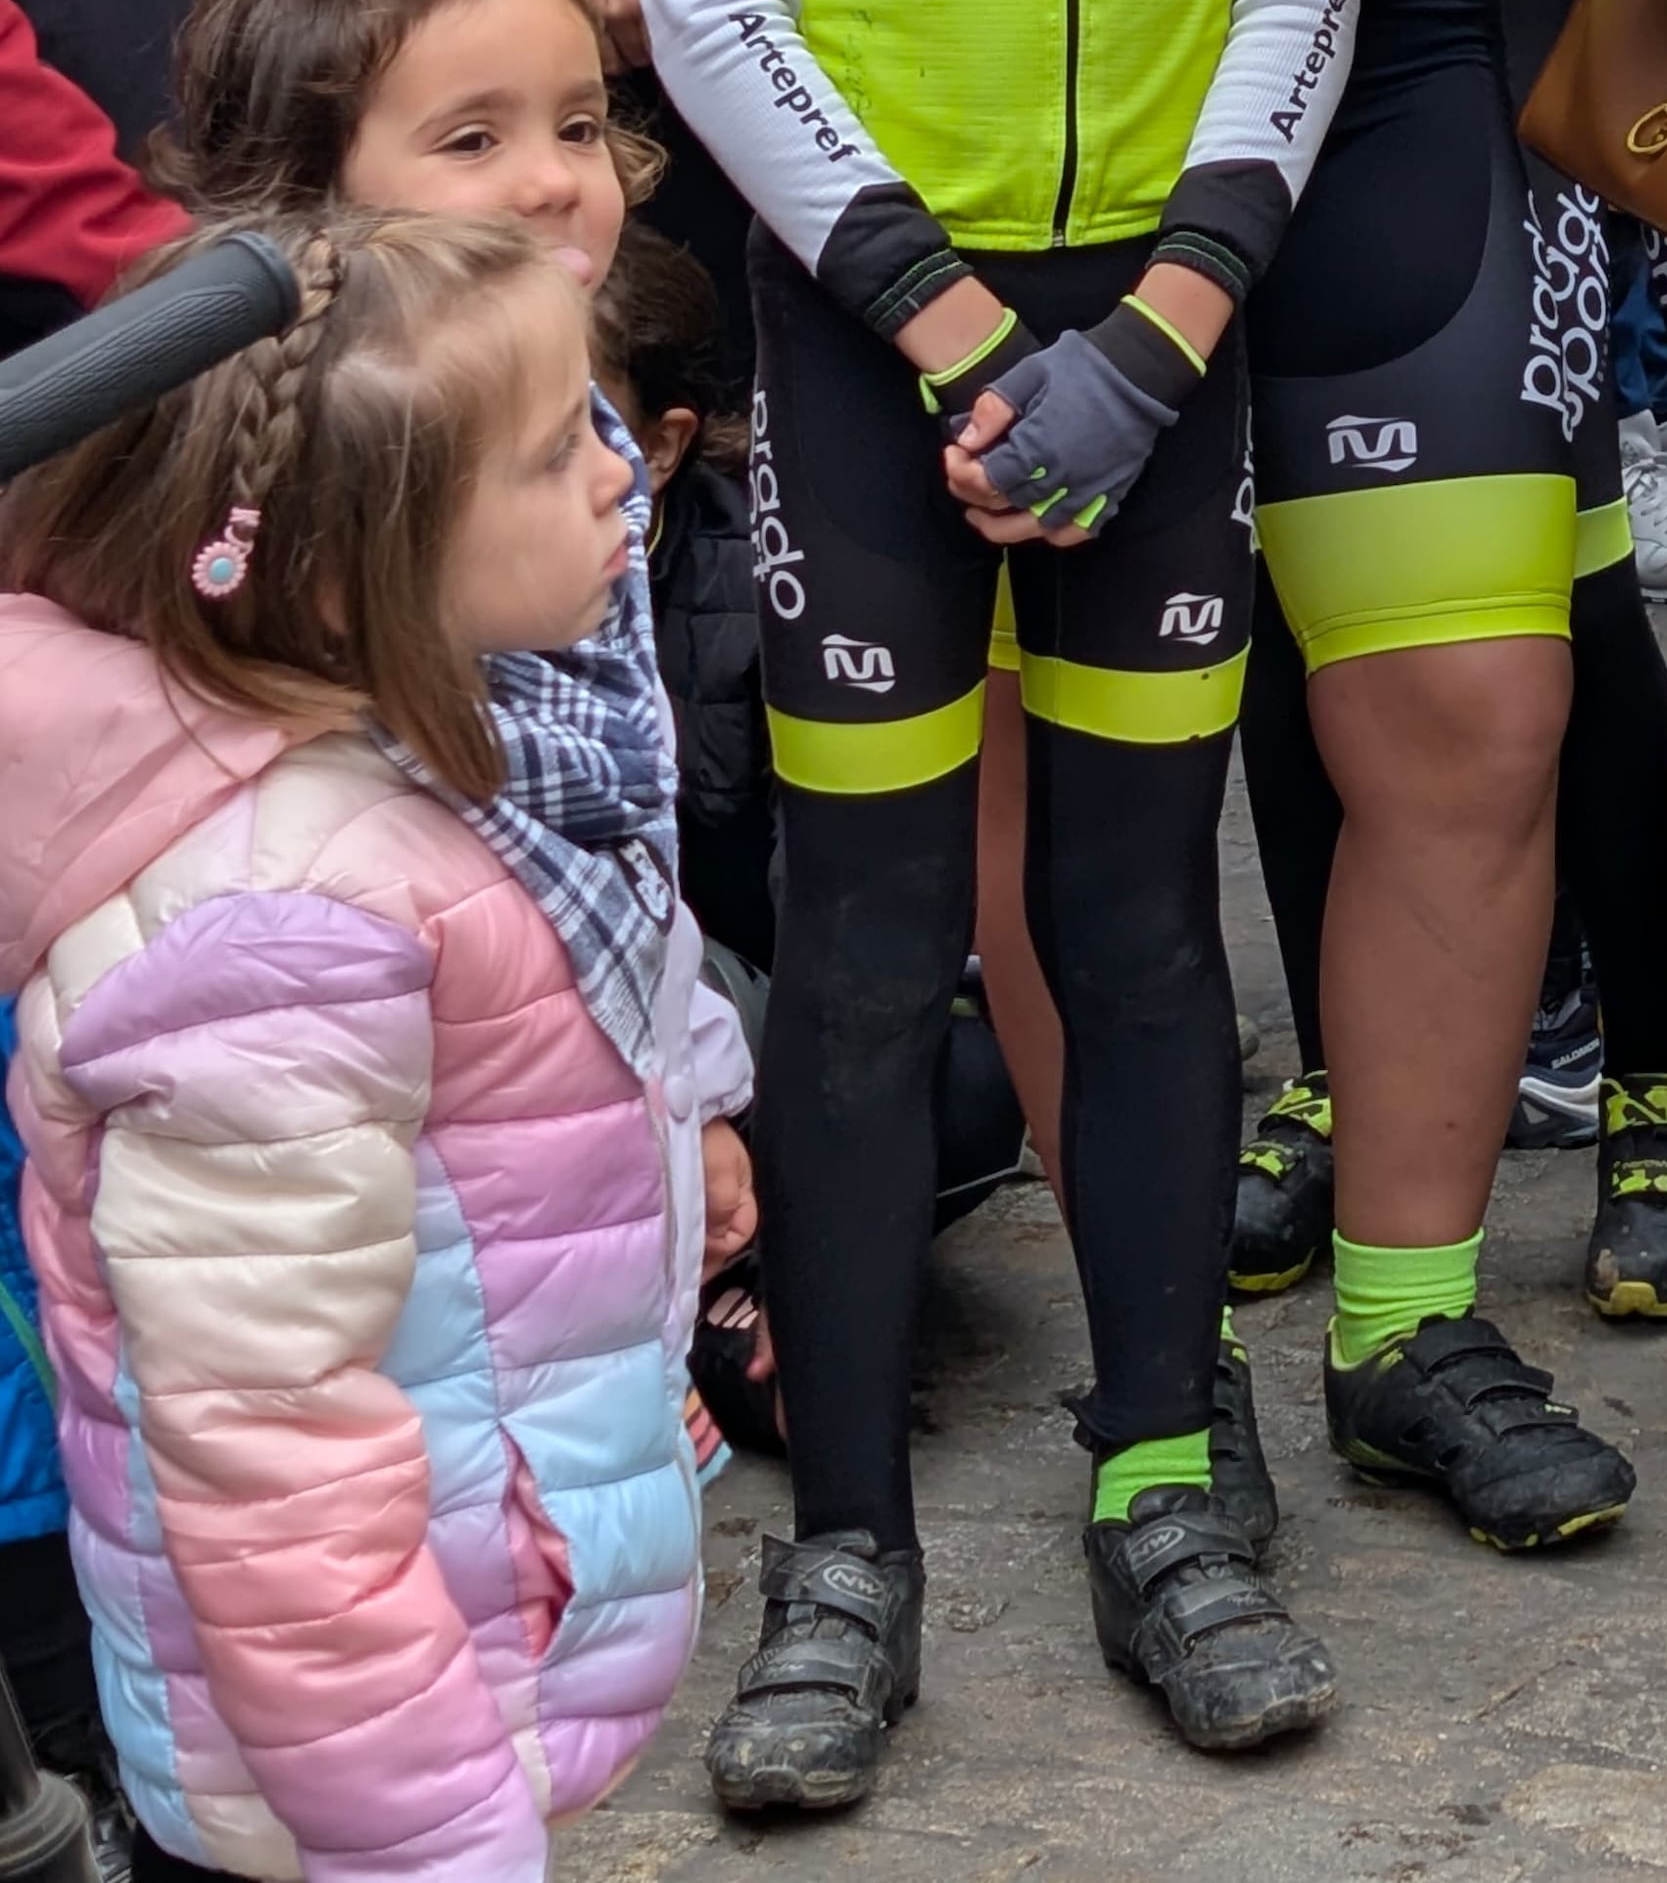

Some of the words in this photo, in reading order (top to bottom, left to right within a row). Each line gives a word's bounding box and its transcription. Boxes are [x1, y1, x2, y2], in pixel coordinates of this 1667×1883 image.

[728, 13, 862, 163] Artepref
[753, 390, 806, 619] prado
[1551, 1037, 1601, 1070] SALOMON
